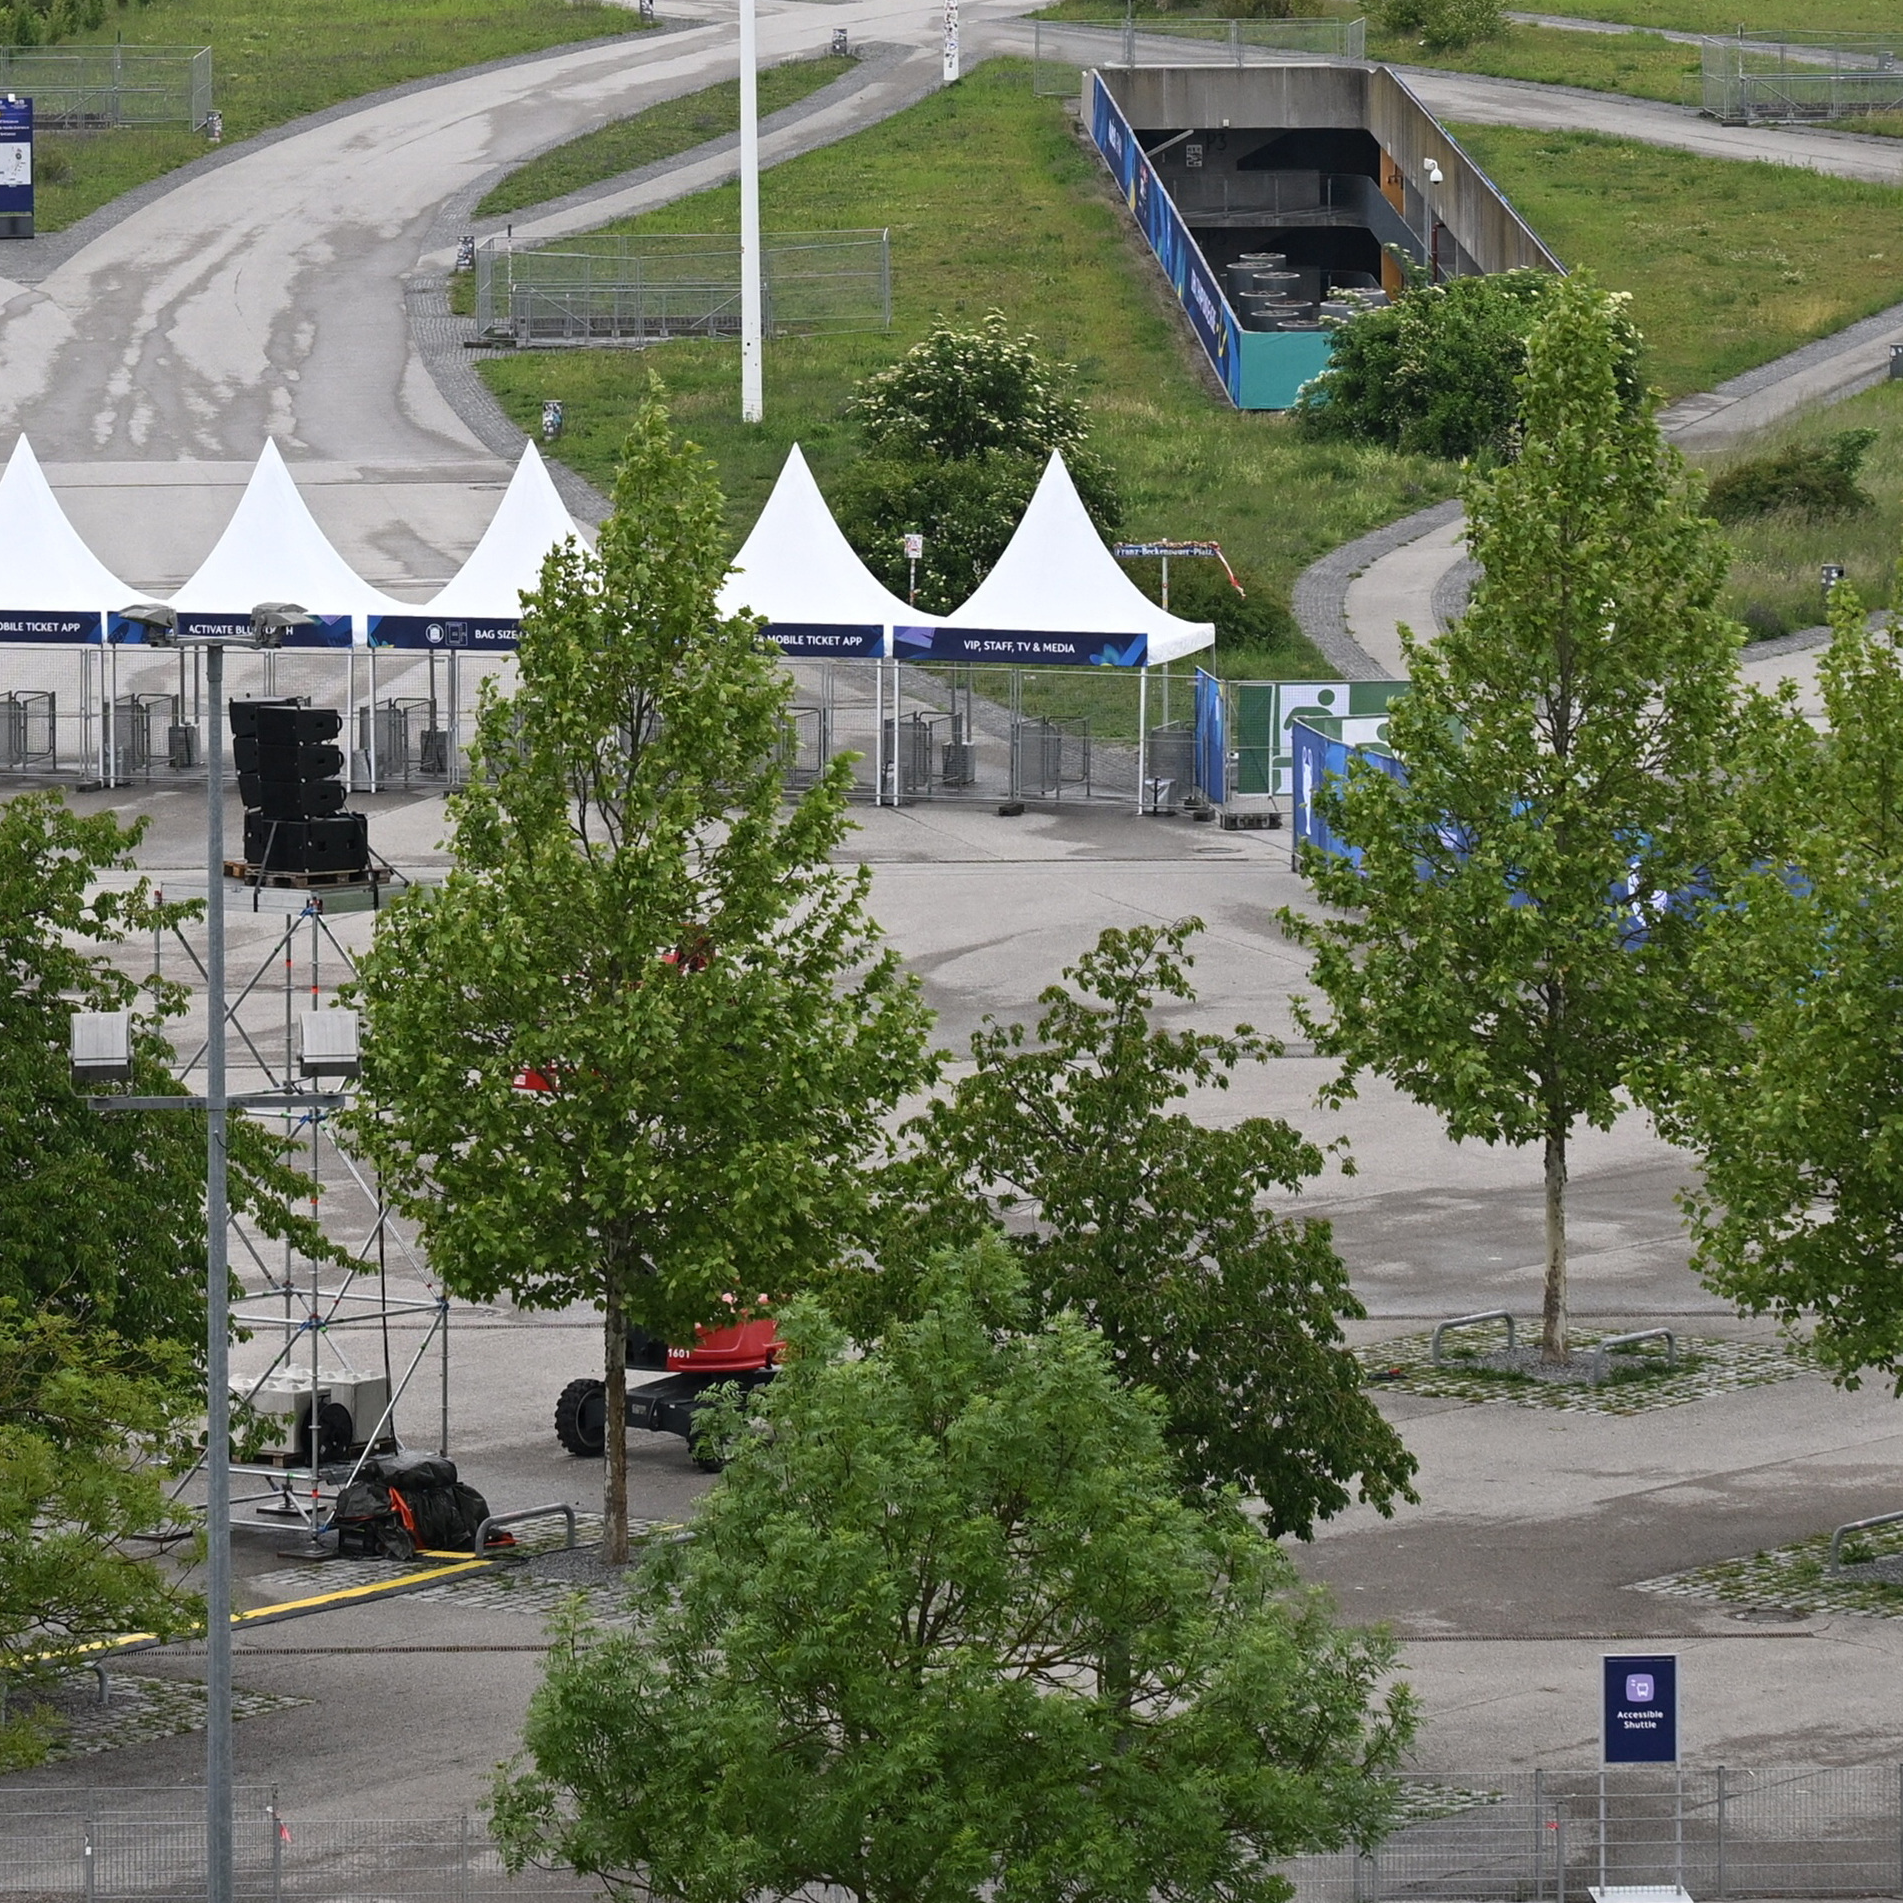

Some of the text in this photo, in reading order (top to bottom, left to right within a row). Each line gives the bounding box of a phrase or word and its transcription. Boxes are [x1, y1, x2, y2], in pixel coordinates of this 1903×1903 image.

[26, 621, 58, 633] TICKET
[60, 621, 81, 633] APP
[188, 624, 234, 635] ACTIVATE
[474, 629, 495, 639] BAG
[497, 629, 517, 639] SIZE
[806, 635, 840, 646] TICKET
[842, 636, 863, 646] APP
[963, 639, 1076, 654] VIP, STAFF, TV & MEDIA
[668, 1348, 691, 1359] 1601
[1617, 1710, 1664, 1719] Accessible
[1623, 1720, 1657, 1729] Shuttle
